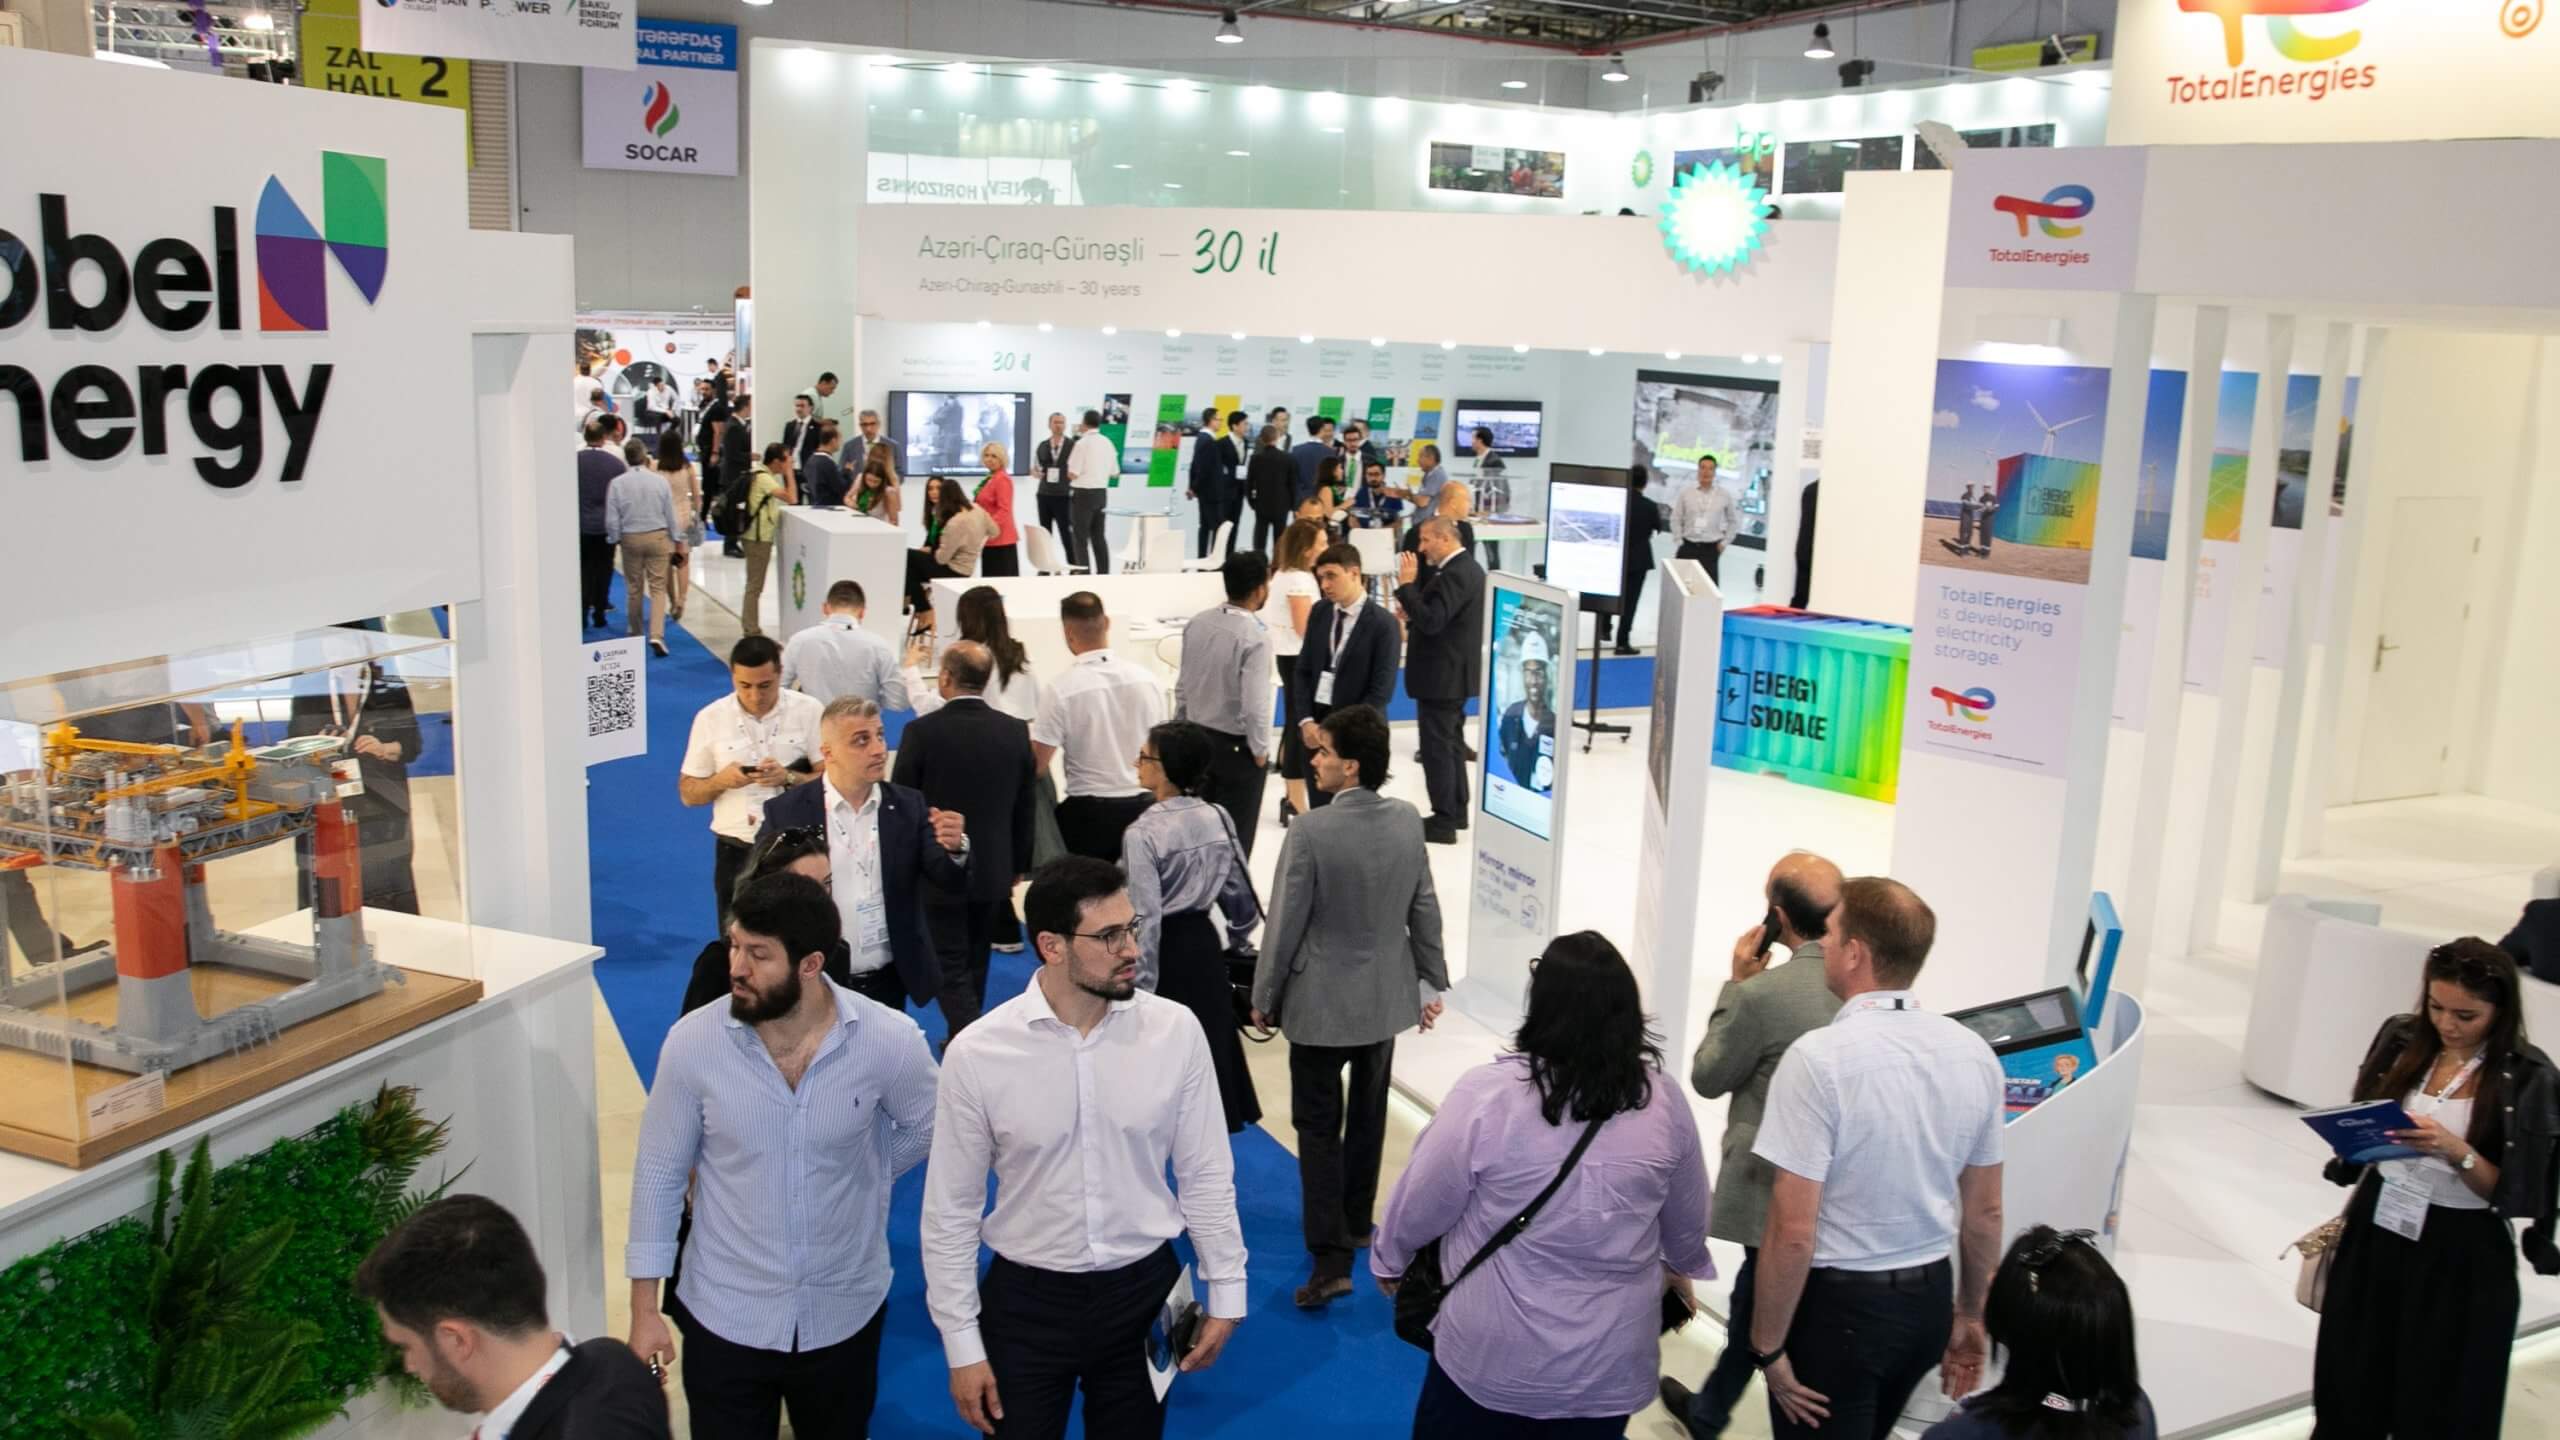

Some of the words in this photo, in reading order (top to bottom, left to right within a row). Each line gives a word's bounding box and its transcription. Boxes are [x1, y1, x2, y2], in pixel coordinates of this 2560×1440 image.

[579, 9, 623, 20] ENERGY
[579, 18, 620, 30] FORUM
[661, 49, 725, 65] PARTNER
[326, 46, 382, 70] ZAL
[421, 56, 448, 97] 2
[2167, 60, 2377, 104] TotalEnergies
[326, 73, 402, 97] HALL
[625, 144, 698, 163] SOCAR
[919, 235, 1144, 266] Azəri-Çıraq-Günəşli
[1192, 228, 1244, 274] 30
[1258, 231, 1279, 275] il
[1989, 248, 2091, 267] TotalEnergies
[1079, 280, 1098, 296] 30
[1102, 283, 1141, 299] years
[992, 351, 1016, 372] 30
[1940, 585, 2062, 616] TotalEnergies
[1936, 607, 1950, 620] is
[1955, 607, 2054, 637] developing
[1935, 625, 2023, 652] electricity
[1928, 720, 1993, 741] TotalEnergies
